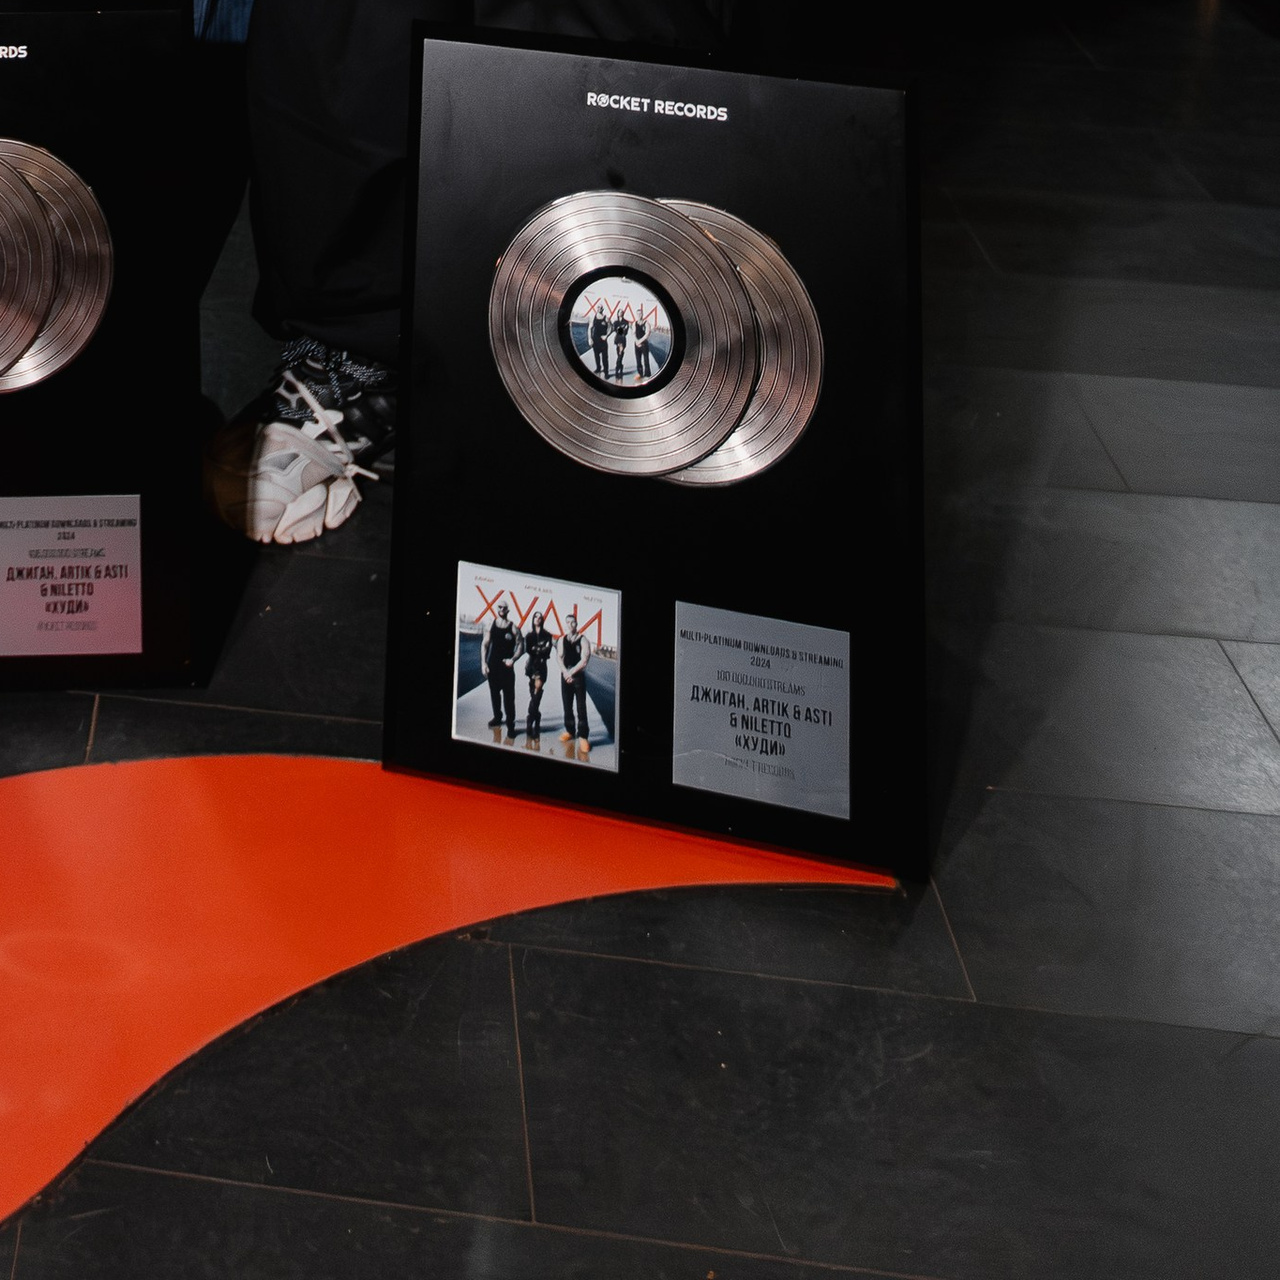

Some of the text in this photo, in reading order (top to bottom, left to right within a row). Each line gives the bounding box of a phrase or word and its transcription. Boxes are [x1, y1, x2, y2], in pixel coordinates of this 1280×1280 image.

[654, 99, 728, 121] RECORDS
[59, 565, 92, 580] ARTIK
[103, 564, 129, 579] ASTI
[50, 582, 94, 597] NILETTO
[45, 599, 89, 615] «ХУДИ»
[680, 628, 742, 650] MULTI-PLATINUM
[743, 642, 790, 659] DOWNLOADS
[799, 651, 844, 669] STREAMING
[750, 656, 771, 669] 2024
[766, 680, 806, 696] STREAMS
[753, 697, 790, 719] ARTIK
[793, 704, 801, 721] &
[804, 707, 833, 727] ASTI
[729, 712, 792, 738] & NILETTO
[734, 734, 786, 756] «ХУДИ»
